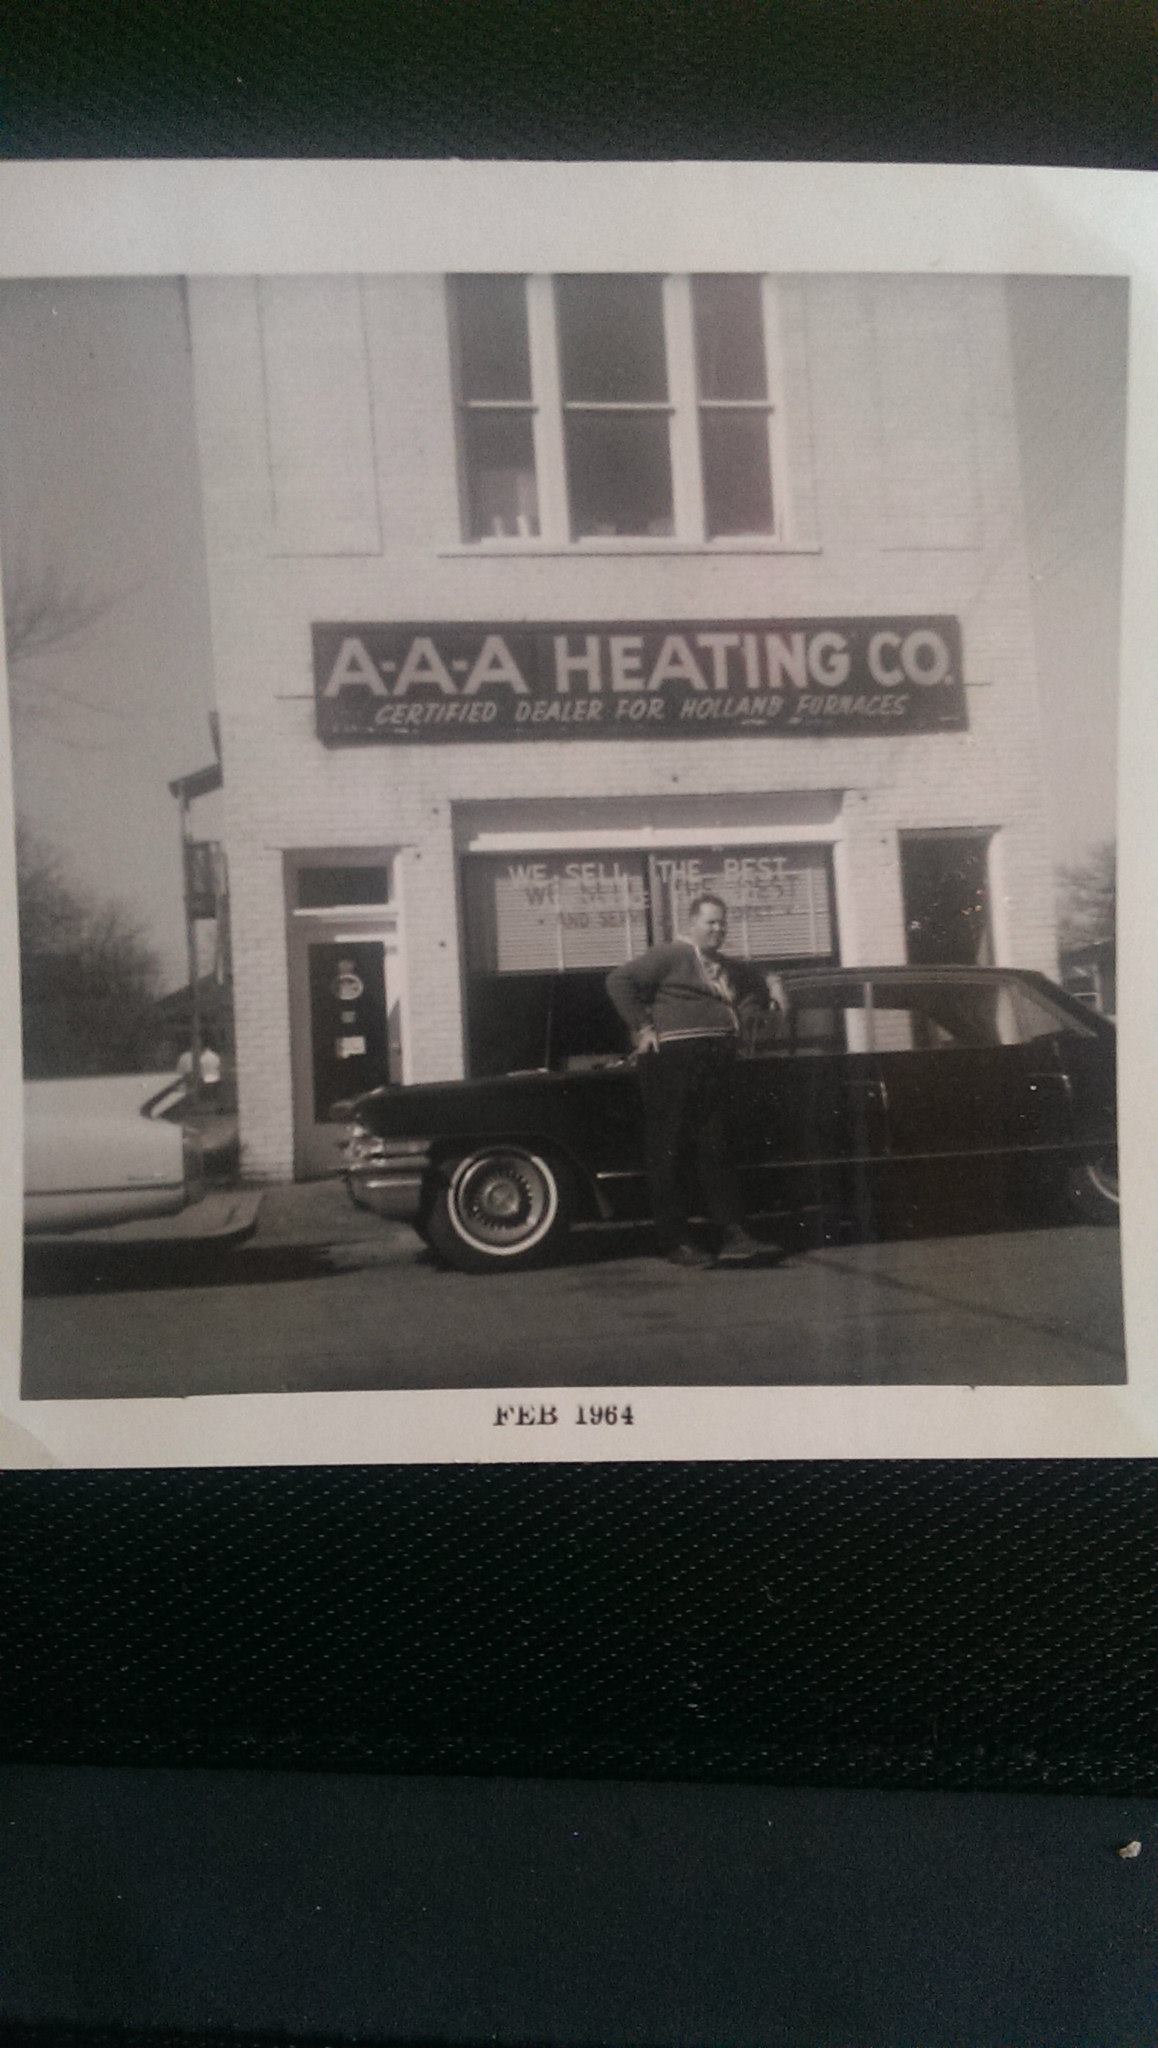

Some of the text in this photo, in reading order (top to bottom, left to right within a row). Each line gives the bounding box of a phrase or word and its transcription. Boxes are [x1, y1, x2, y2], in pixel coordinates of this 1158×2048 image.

[323, 629, 954, 696] A-A-A HEATING CO.
[374, 693, 910, 725] CERTIFIED DEALER FOR HOLLAND FURNACES
[508, 857, 788, 885] WE SELL THE BEST
